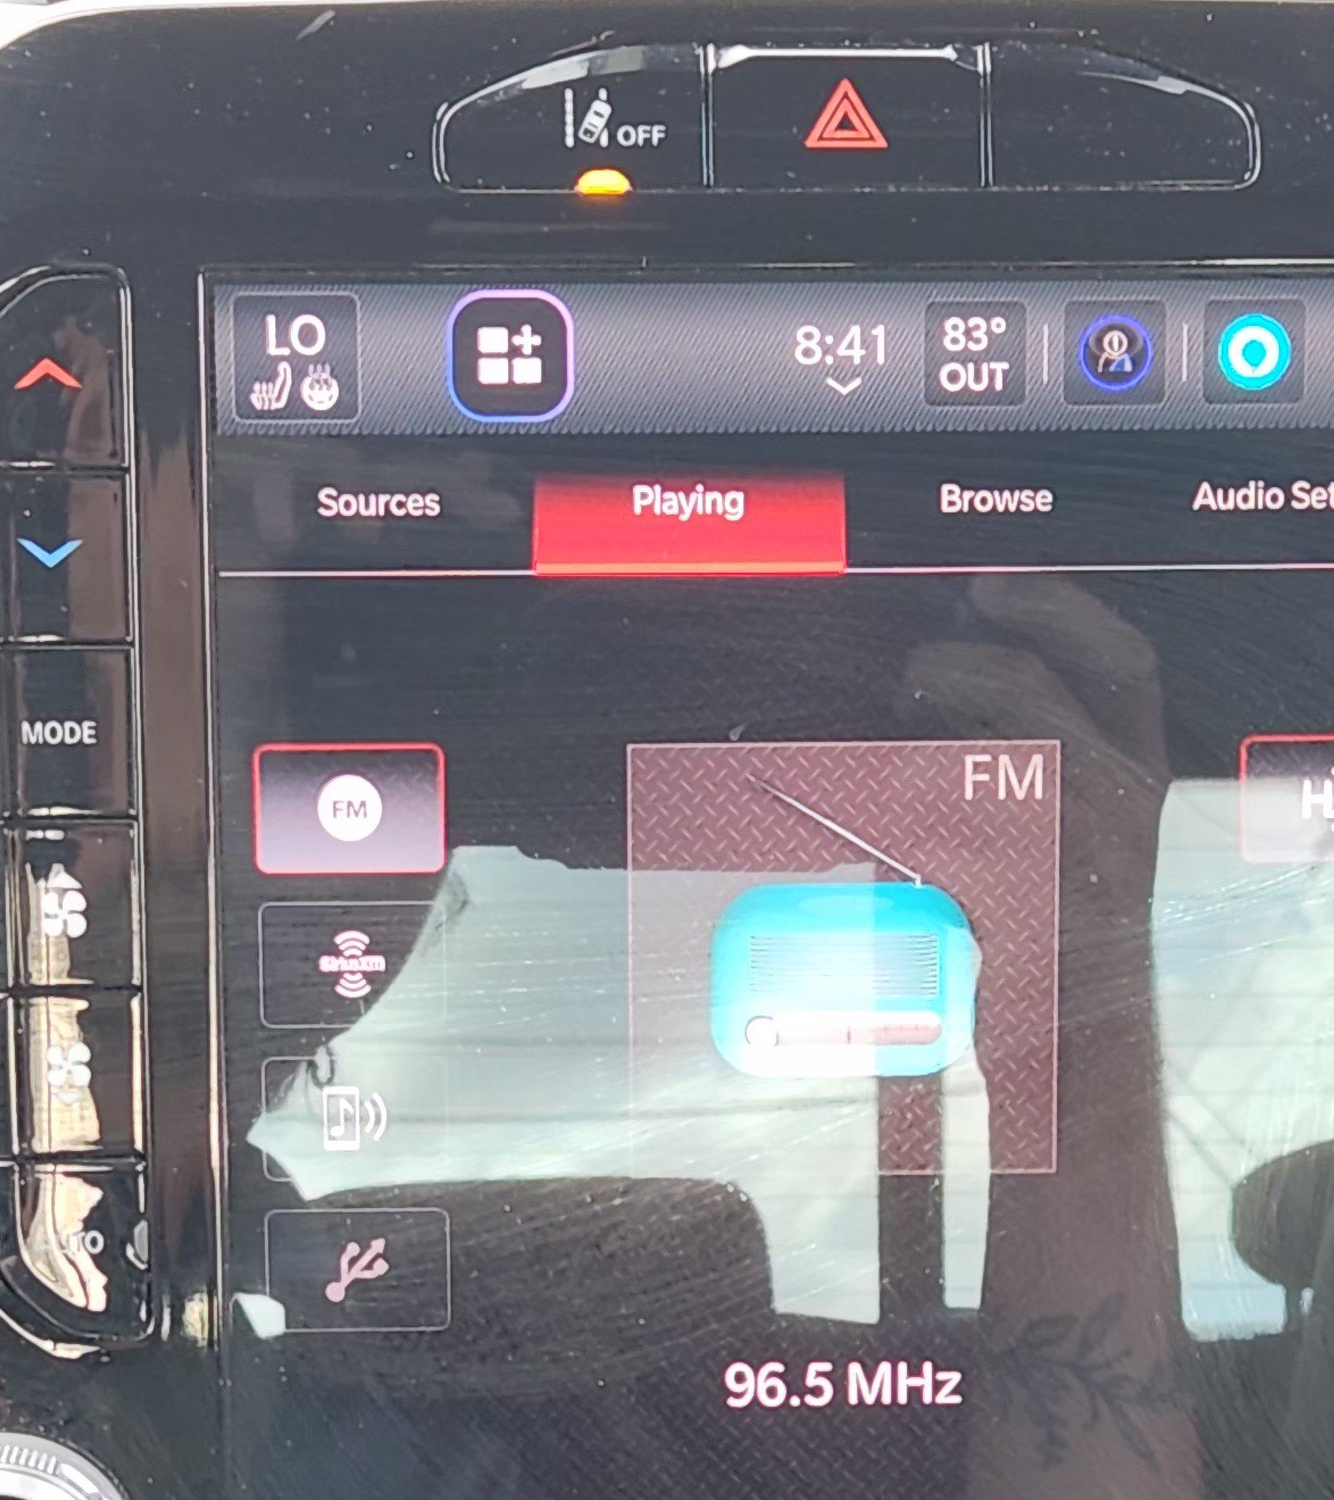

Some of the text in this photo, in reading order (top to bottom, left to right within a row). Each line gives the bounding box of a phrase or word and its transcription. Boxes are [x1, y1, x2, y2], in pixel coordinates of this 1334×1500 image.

[618, 125, 666, 147] OFF
[266, 314, 326, 356] LO
[793, 325, 886, 366] 8:41
[939, 362, 1009, 392] OUT
[317, 487, 440, 518] Sources
[632, 484, 744, 521] Playing
[940, 483, 1054, 514] Browse
[1193, 482, 1285, 512] Audio
[21, 720, 98, 745] MODE
[964, 754, 1044, 800] FM
[332, 800, 367, 818] FM
[724, 1361, 963, 1408] 96.5 MHz
